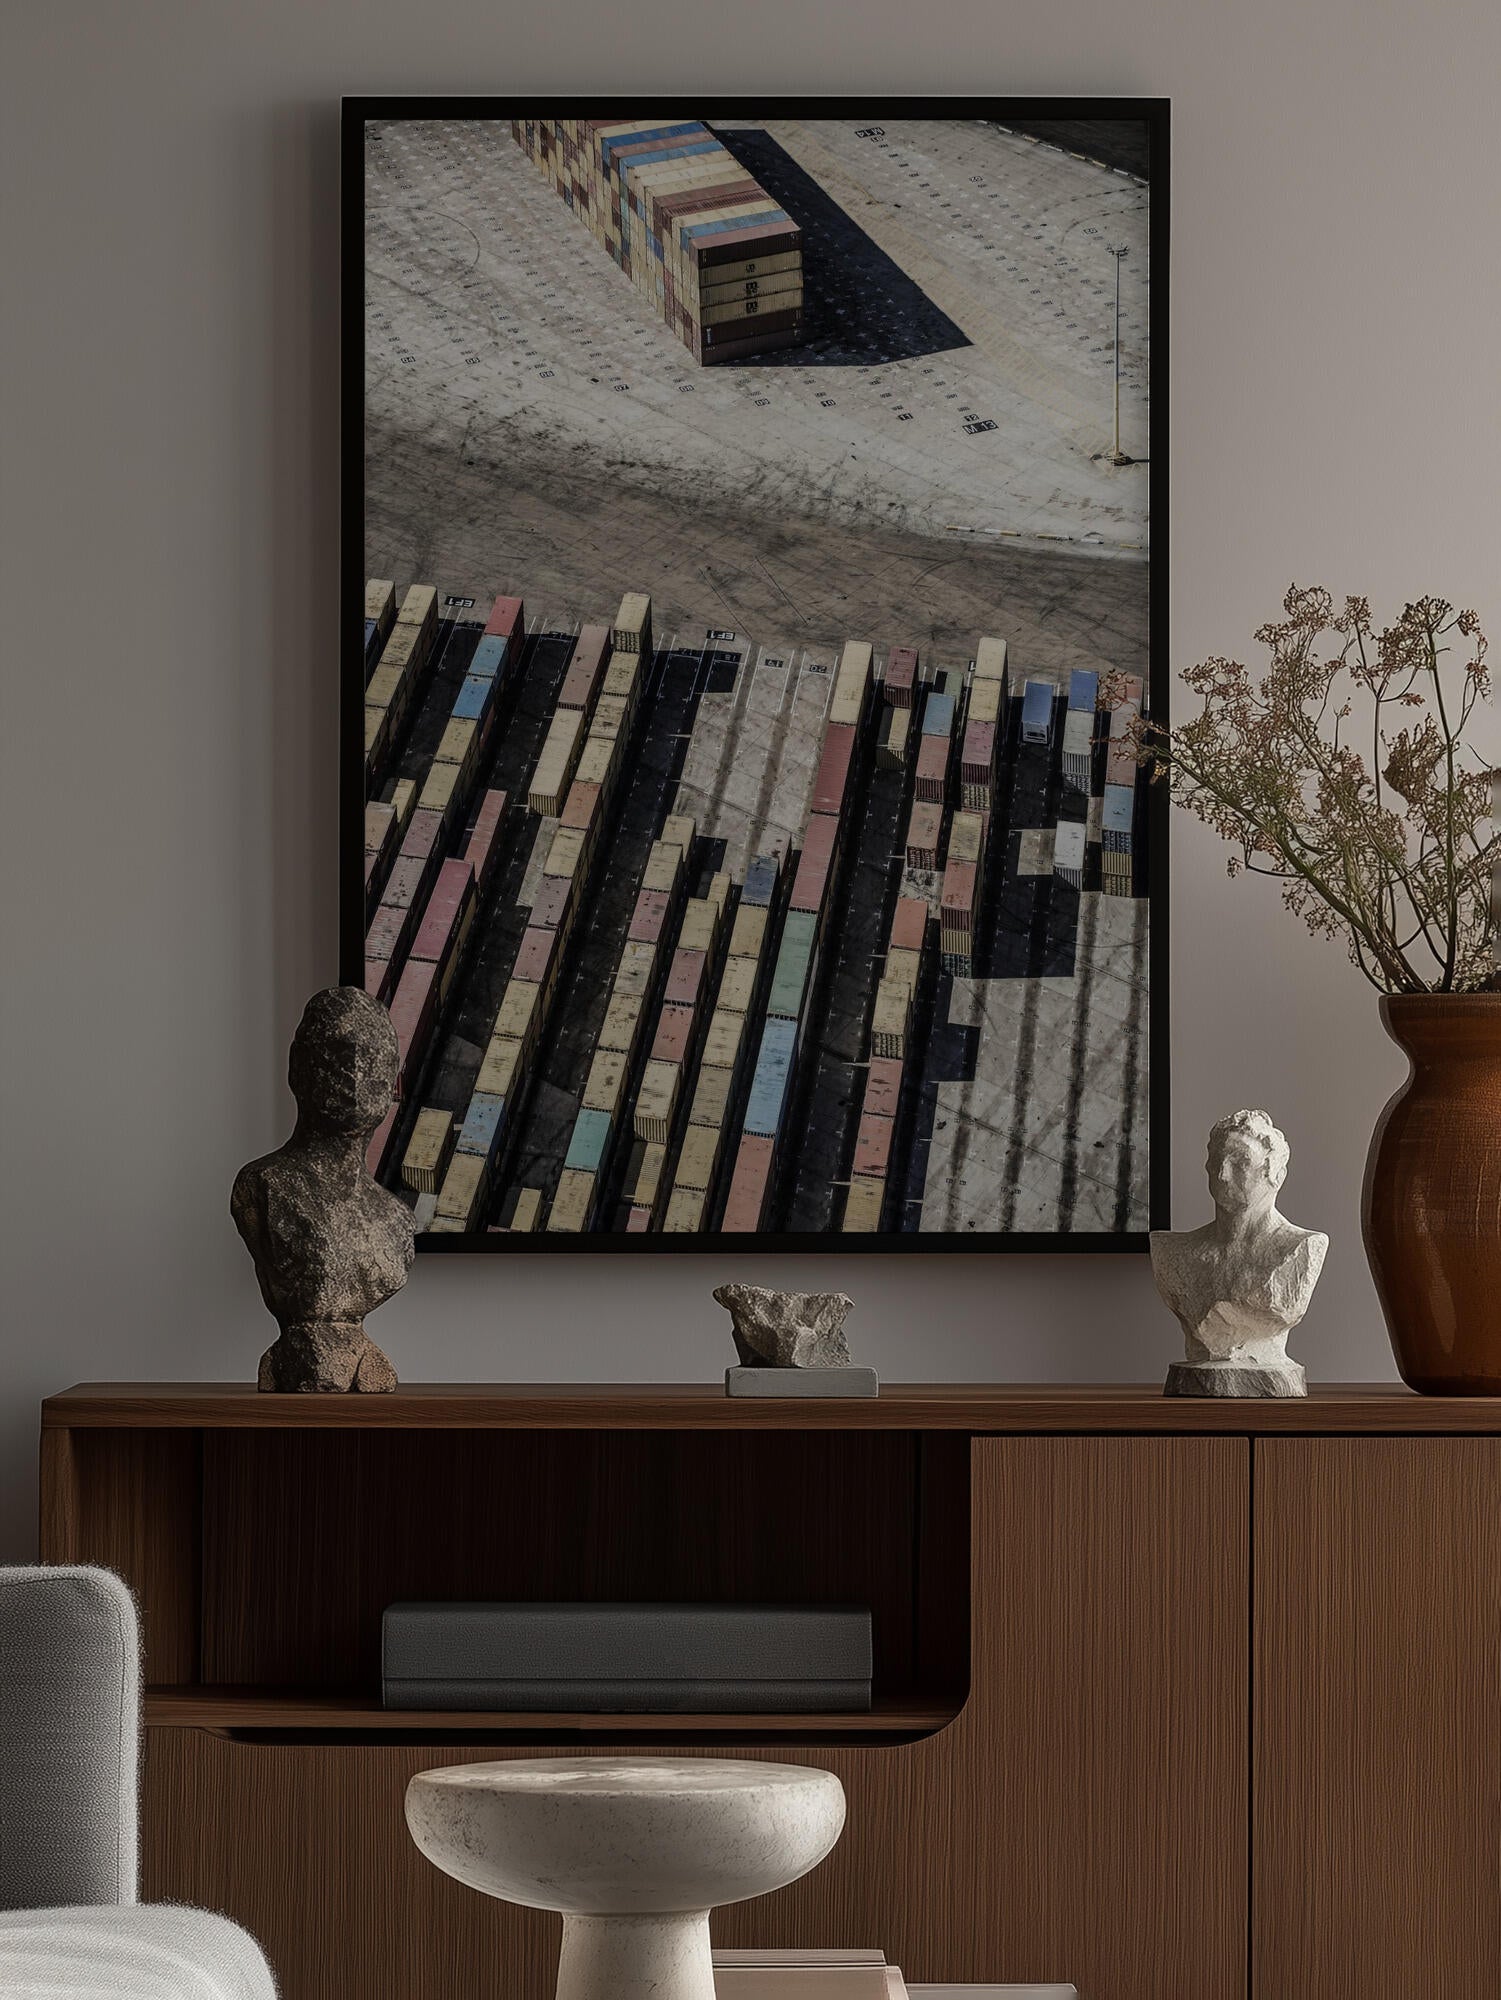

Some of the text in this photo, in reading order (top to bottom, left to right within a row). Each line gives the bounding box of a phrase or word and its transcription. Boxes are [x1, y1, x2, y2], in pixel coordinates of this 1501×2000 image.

[964, 420, 998, 435] M 13
[447, 597, 474, 608] EF1
[709, 630, 735, 641] EF1
